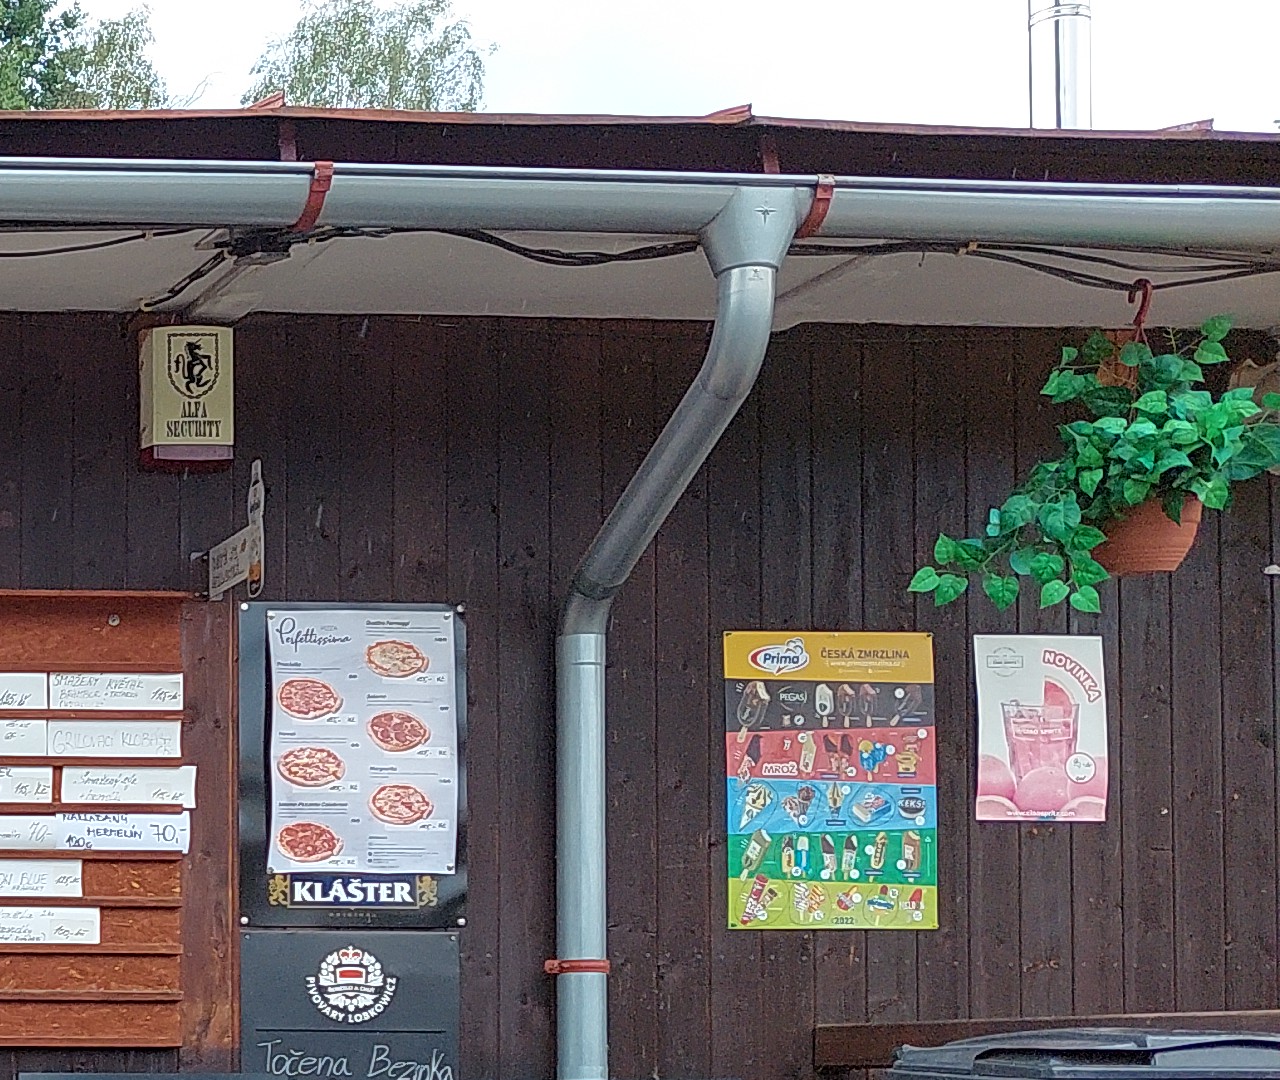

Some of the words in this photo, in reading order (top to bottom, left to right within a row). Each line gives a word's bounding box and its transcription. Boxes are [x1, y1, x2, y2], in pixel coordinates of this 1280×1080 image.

[180, 401, 207, 418] ALFA
[166, 420, 221, 438] SECURITY
[276, 617, 352, 652] Perfettissima
[763, 652, 800, 666] Prima
[820, 647, 855, 659] ČESKÁ
[857, 649, 910, 659] ZMRZLINA
[1042, 649, 1101, 703] NOVINKA
[780, 692, 806, 702] PEGAS
[763, 764, 797, 775] MROŽ
[149, 824, 187, 844] 70,-
[293, 874, 414, 903] KLÁŠTER
[834, 915, 855, 926] 2022
[305, 976, 344, 1023] PIVOVARY
[347, 977, 396, 1024] LOBKOWICZ
